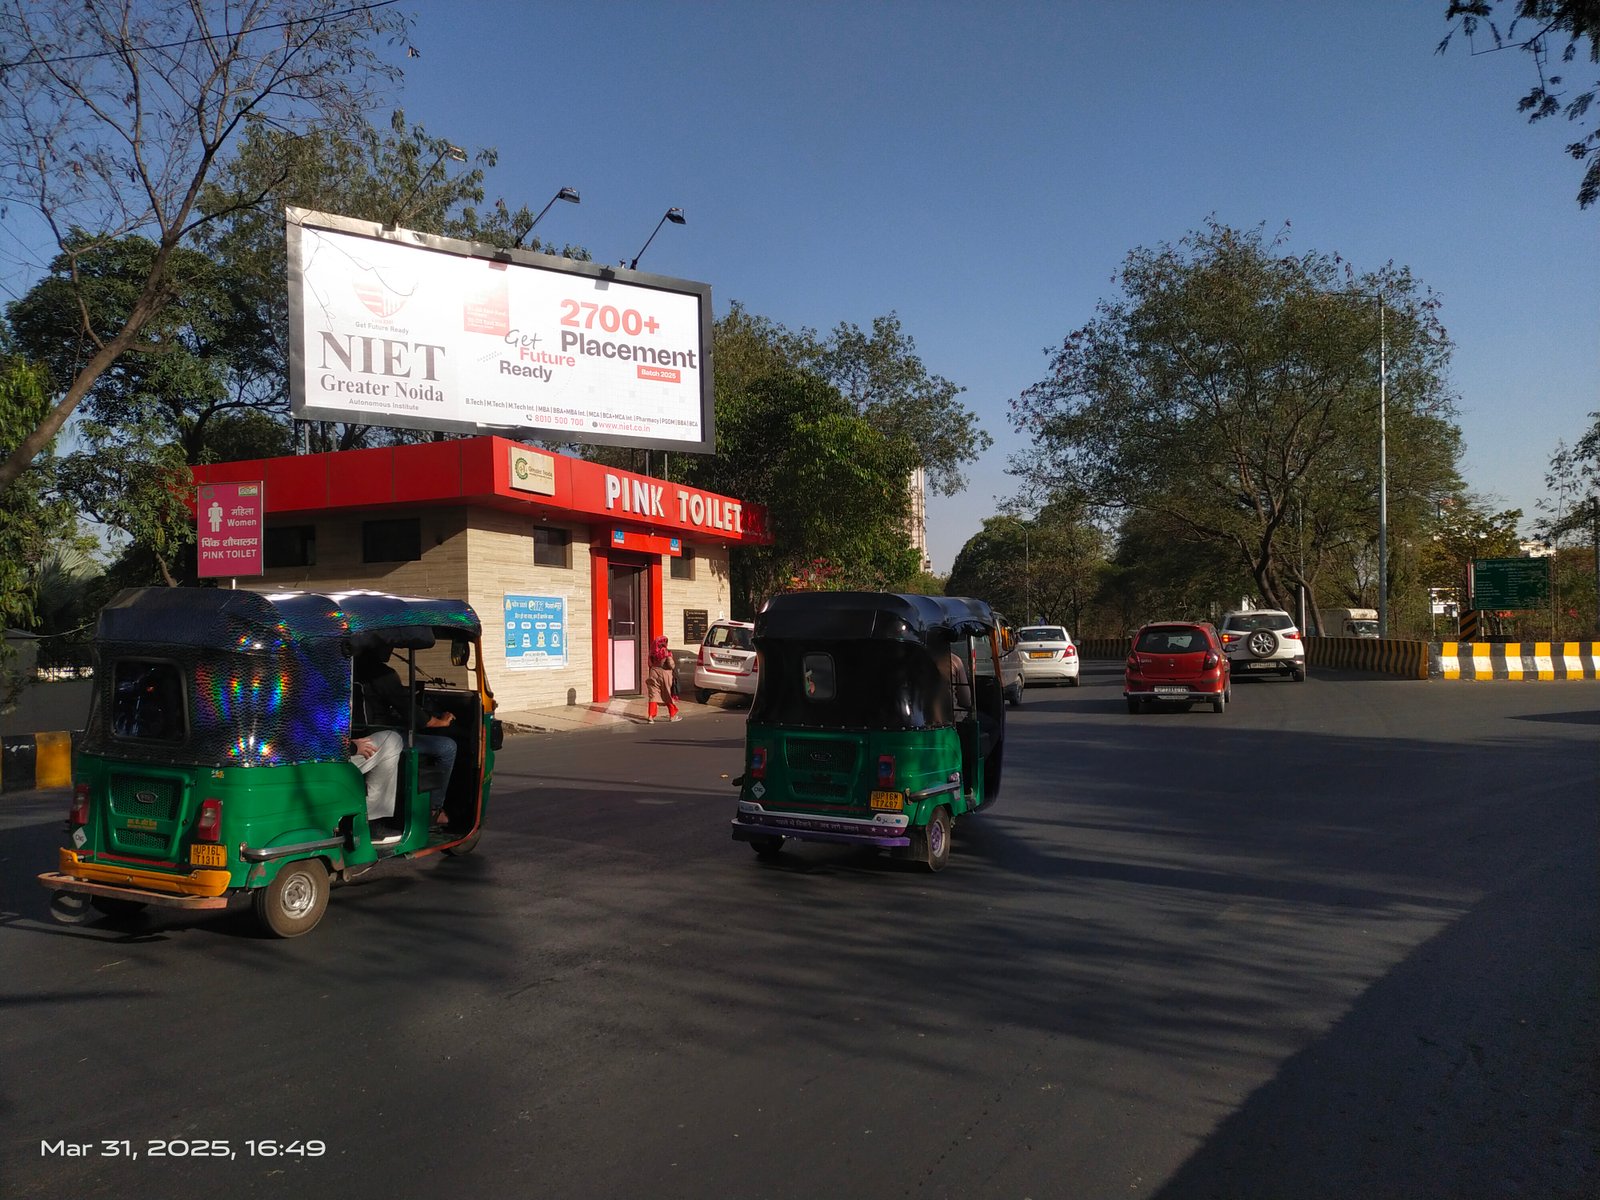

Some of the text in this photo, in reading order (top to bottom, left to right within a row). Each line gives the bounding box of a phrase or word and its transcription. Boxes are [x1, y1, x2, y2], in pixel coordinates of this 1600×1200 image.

[560, 298, 660, 336] 2700+
[368, 322, 389, 332] Future
[390, 325, 409, 335] Ready
[504, 329, 543, 350] Get
[317, 330, 446, 382] NIET
[561, 330, 697, 369] Placement
[520, 346, 576, 367] Future
[499, 359, 553, 383] Ready
[320, 373, 444, 402] Greater Noida
[349, 398, 419, 411] Autonomous Institute
[486, 400, 506, 408] M.Tech
[508, 402, 526, 410] M.Tech
[535, 415, 584, 426] 8010 500 700
[599, 422, 651, 433] www.niet.co.in
[604, 473, 743, 534] PINK TOILET
[230, 505, 254, 516] महिला
[227, 518, 257, 527] Women
[202, 549, 257, 560] PINK TOILET
[196, 845, 220, 856] UP16L
[196, 855, 220, 865] T1311
